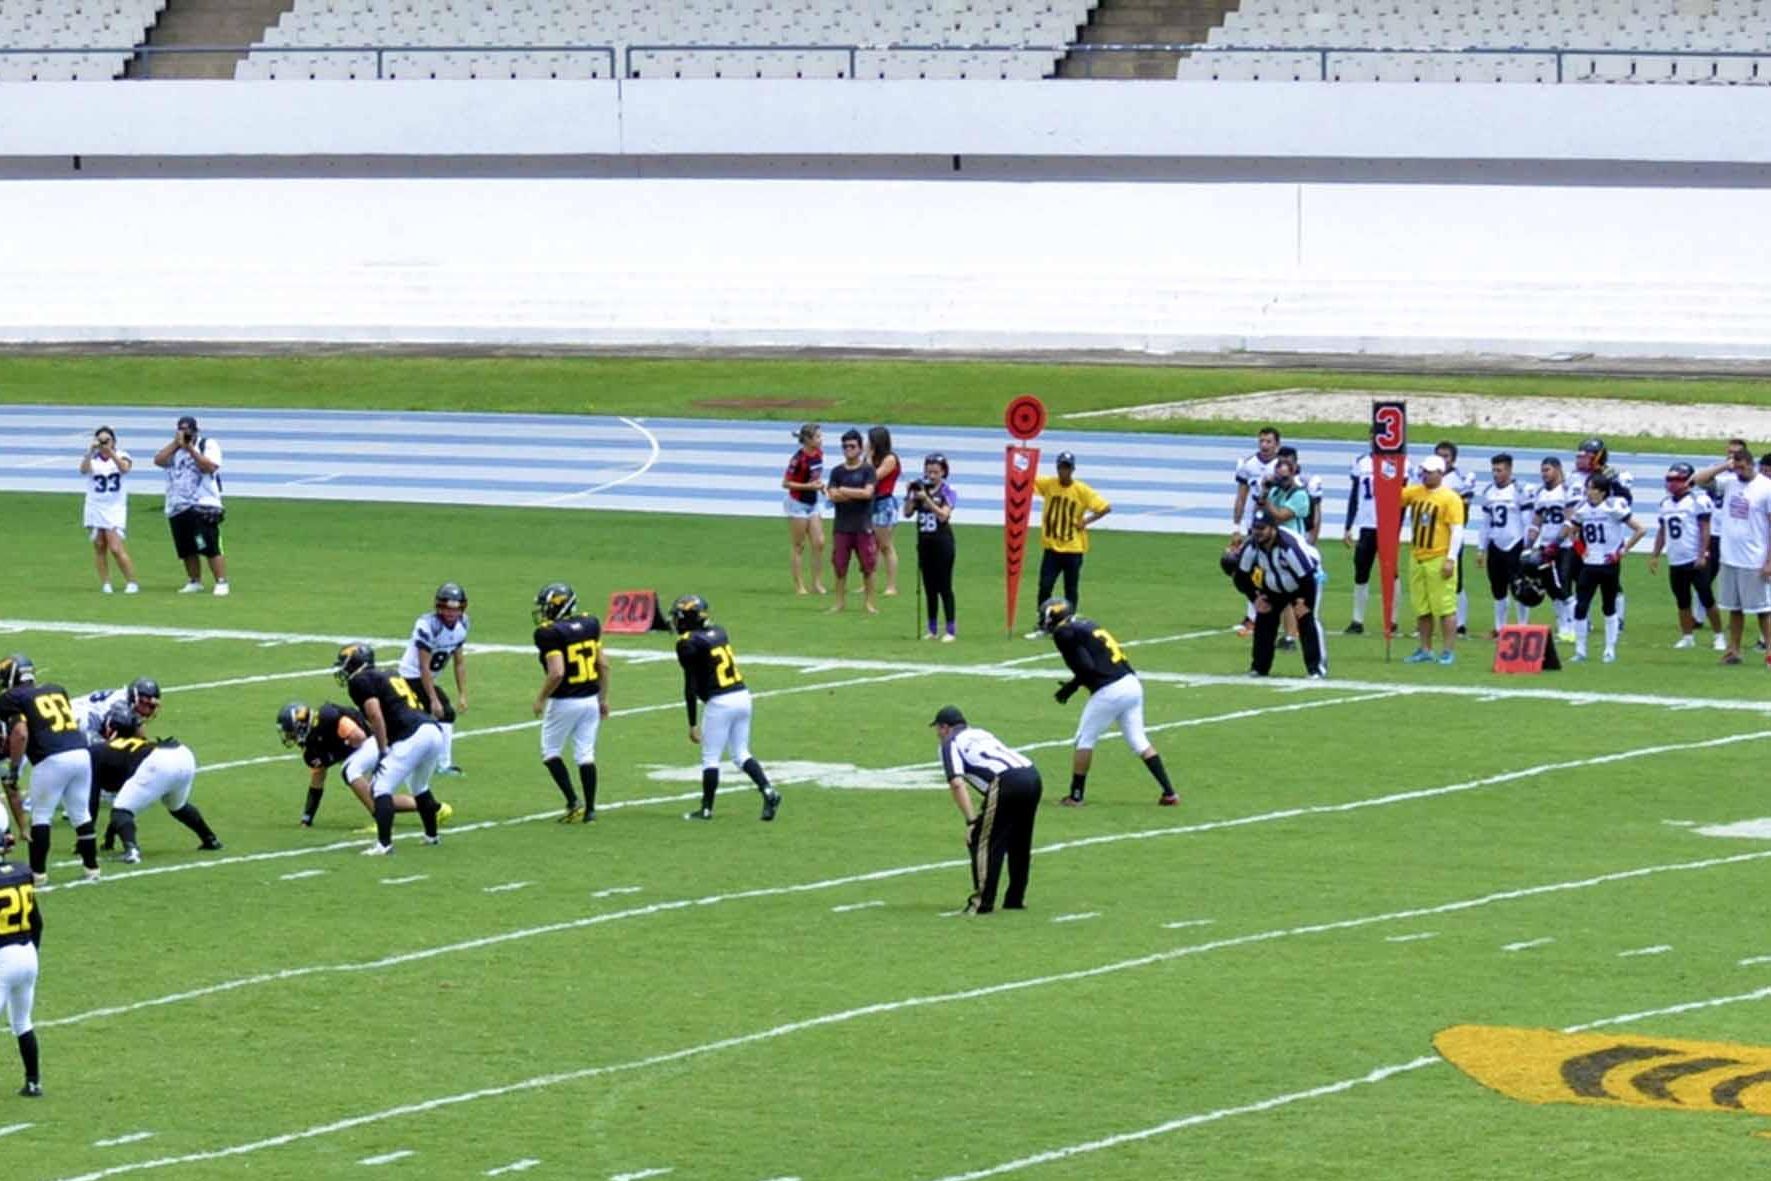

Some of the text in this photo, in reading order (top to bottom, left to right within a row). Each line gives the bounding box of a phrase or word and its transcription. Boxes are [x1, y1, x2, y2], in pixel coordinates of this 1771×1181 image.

[1375, 406, 1405, 450] 3
[93, 472, 121, 493] 33
[1584, 522, 1607, 544] 81
[610, 594, 649, 622] 20
[1499, 631, 1544, 663] 30
